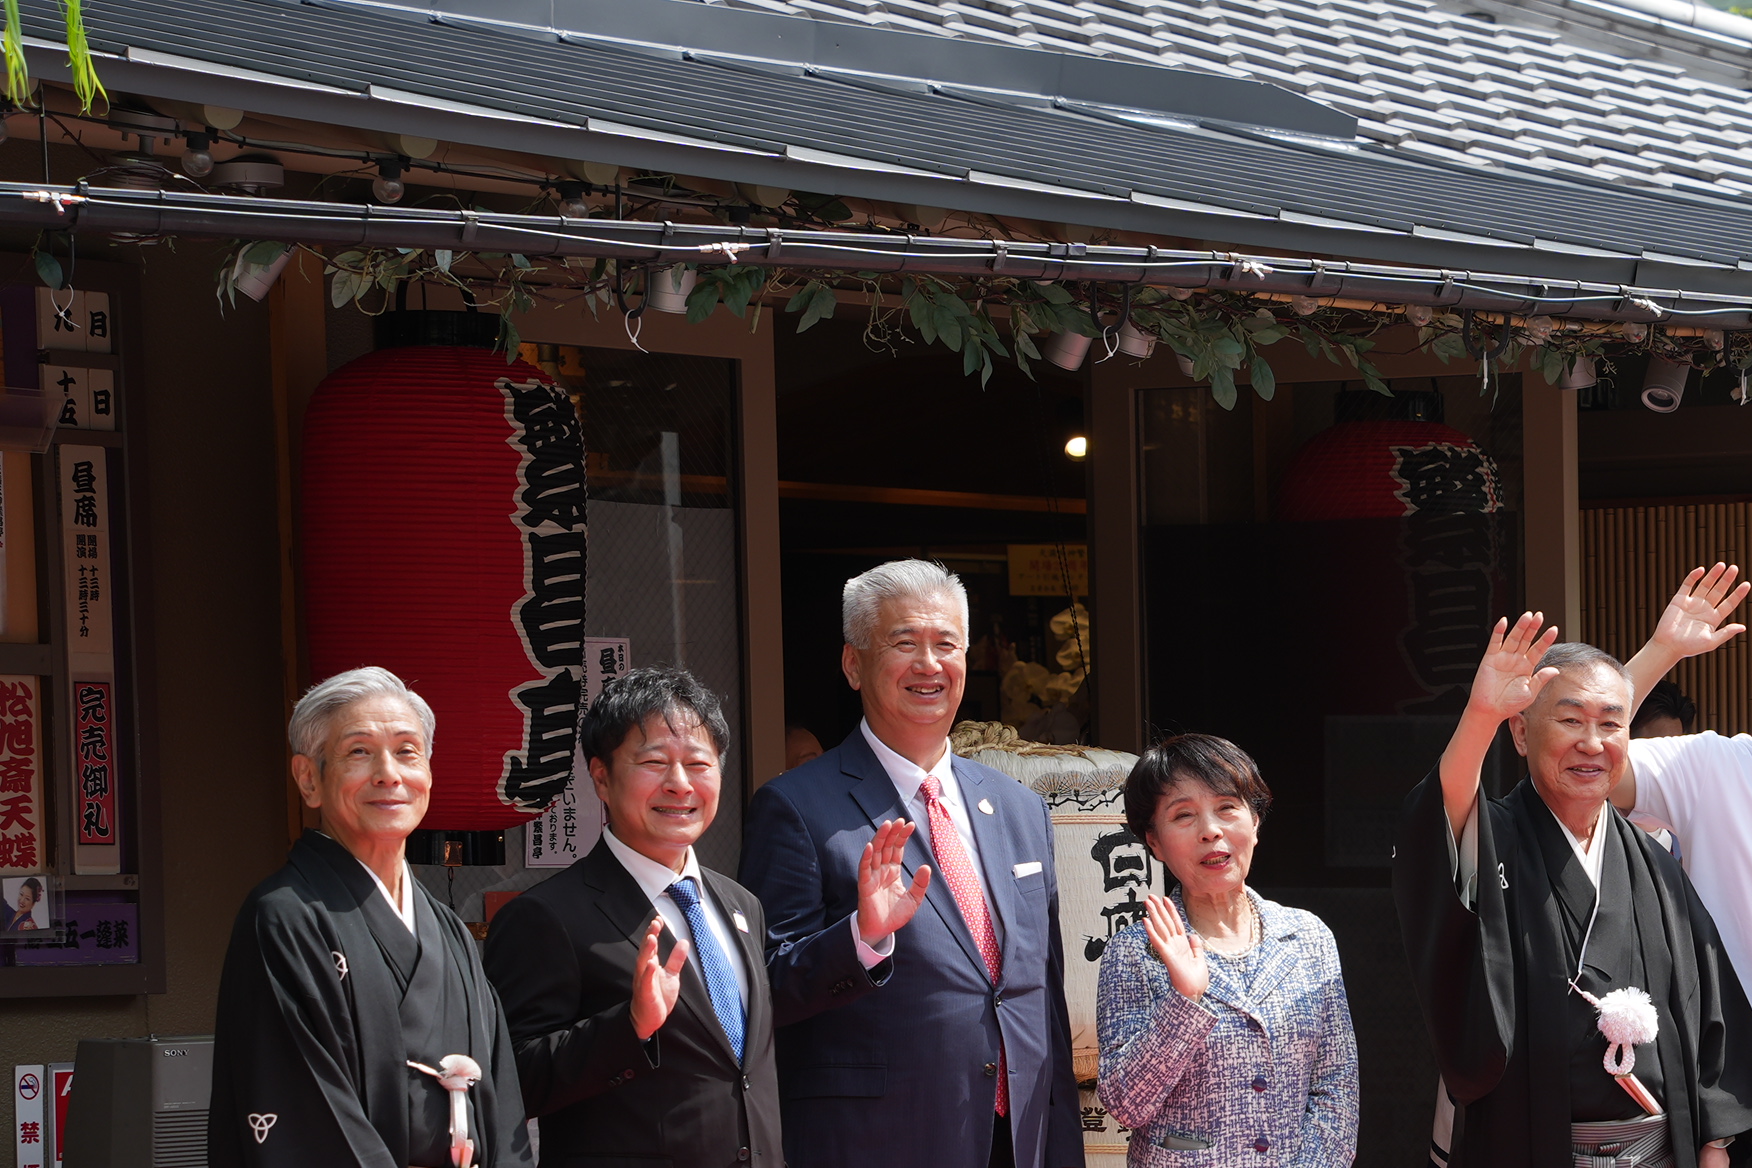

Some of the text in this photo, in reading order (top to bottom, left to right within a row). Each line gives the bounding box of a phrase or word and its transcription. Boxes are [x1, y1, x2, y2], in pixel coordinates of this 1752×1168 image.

[71, 461, 98, 528] 昼席
[79, 686, 110, 838] 完売御礼
[164, 1048, 190, 1057] SONY
